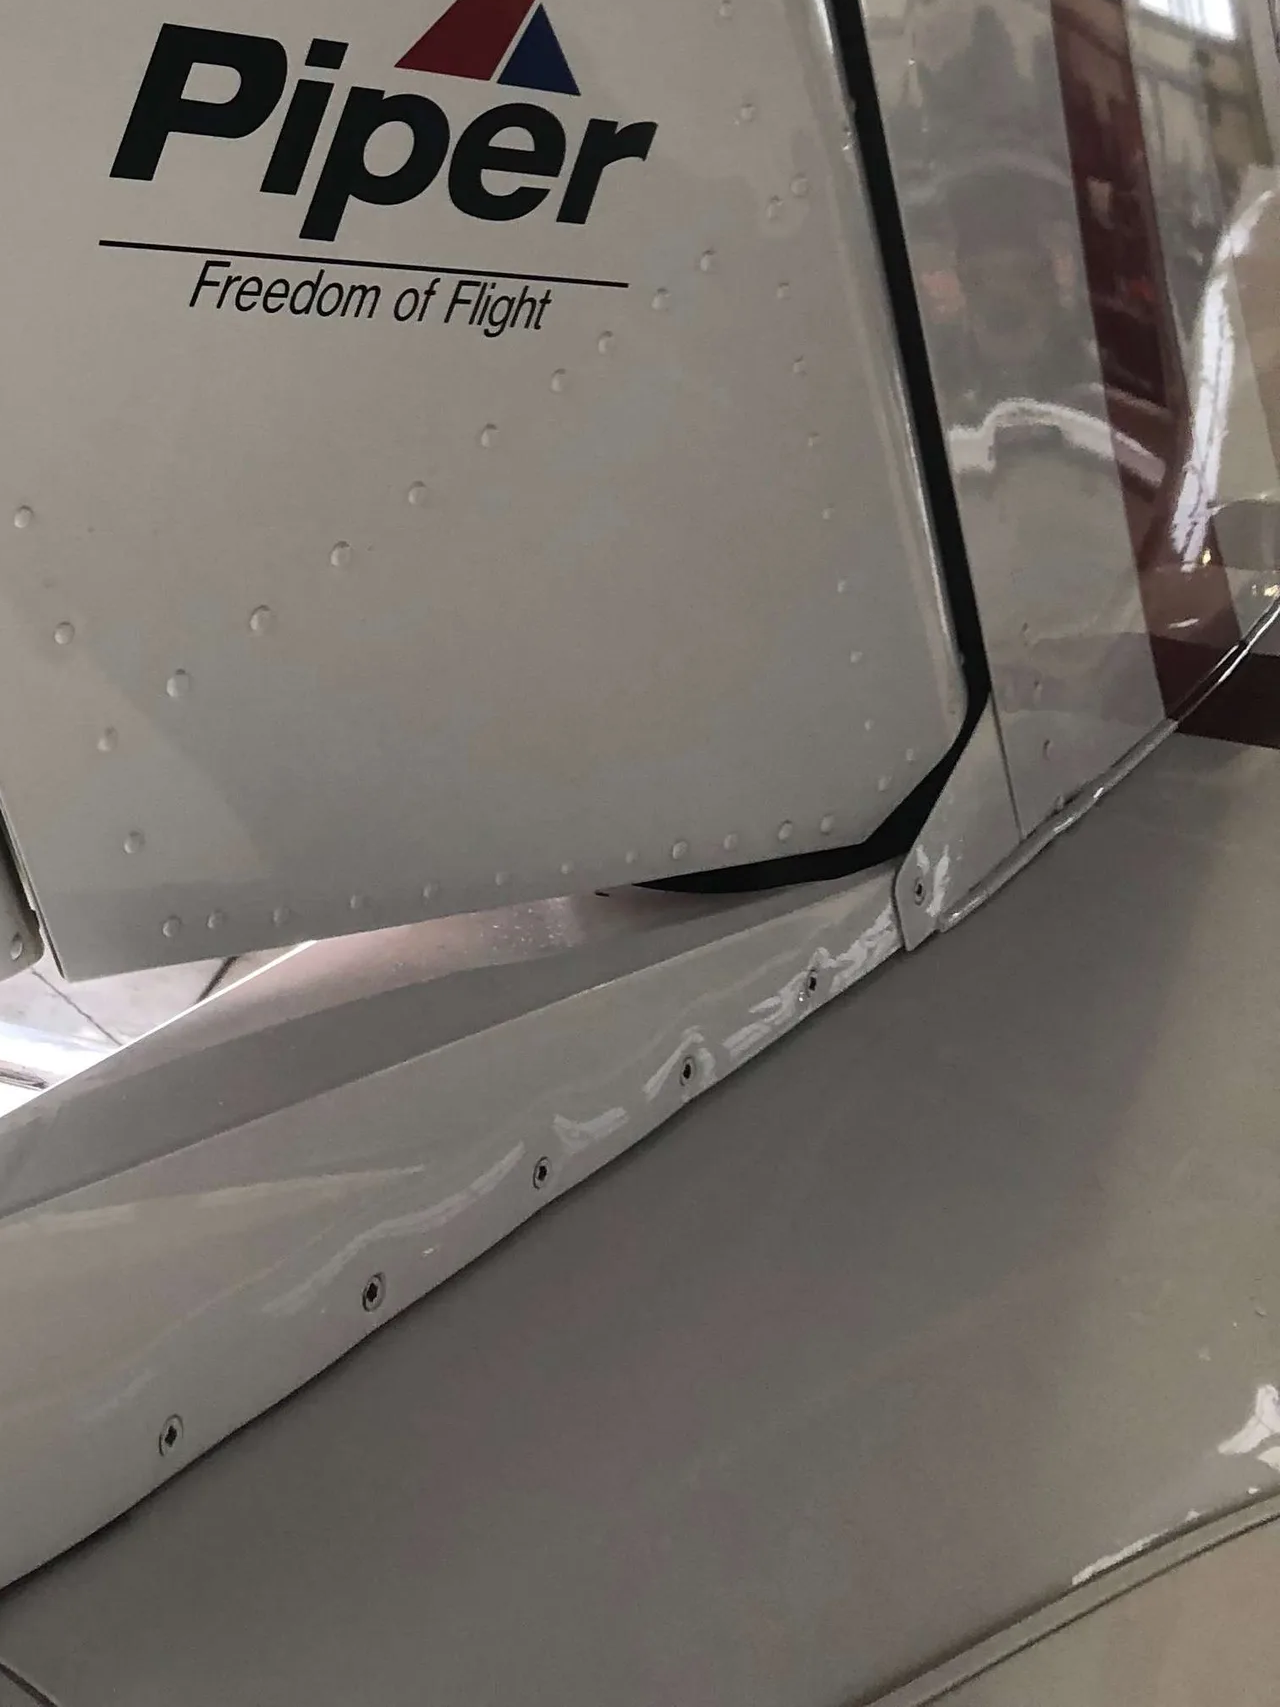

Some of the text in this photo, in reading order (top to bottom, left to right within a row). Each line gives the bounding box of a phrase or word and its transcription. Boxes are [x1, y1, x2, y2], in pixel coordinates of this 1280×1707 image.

[109, 22, 659, 242] Piper
[188, 259, 553, 339] Freedom of Flight
